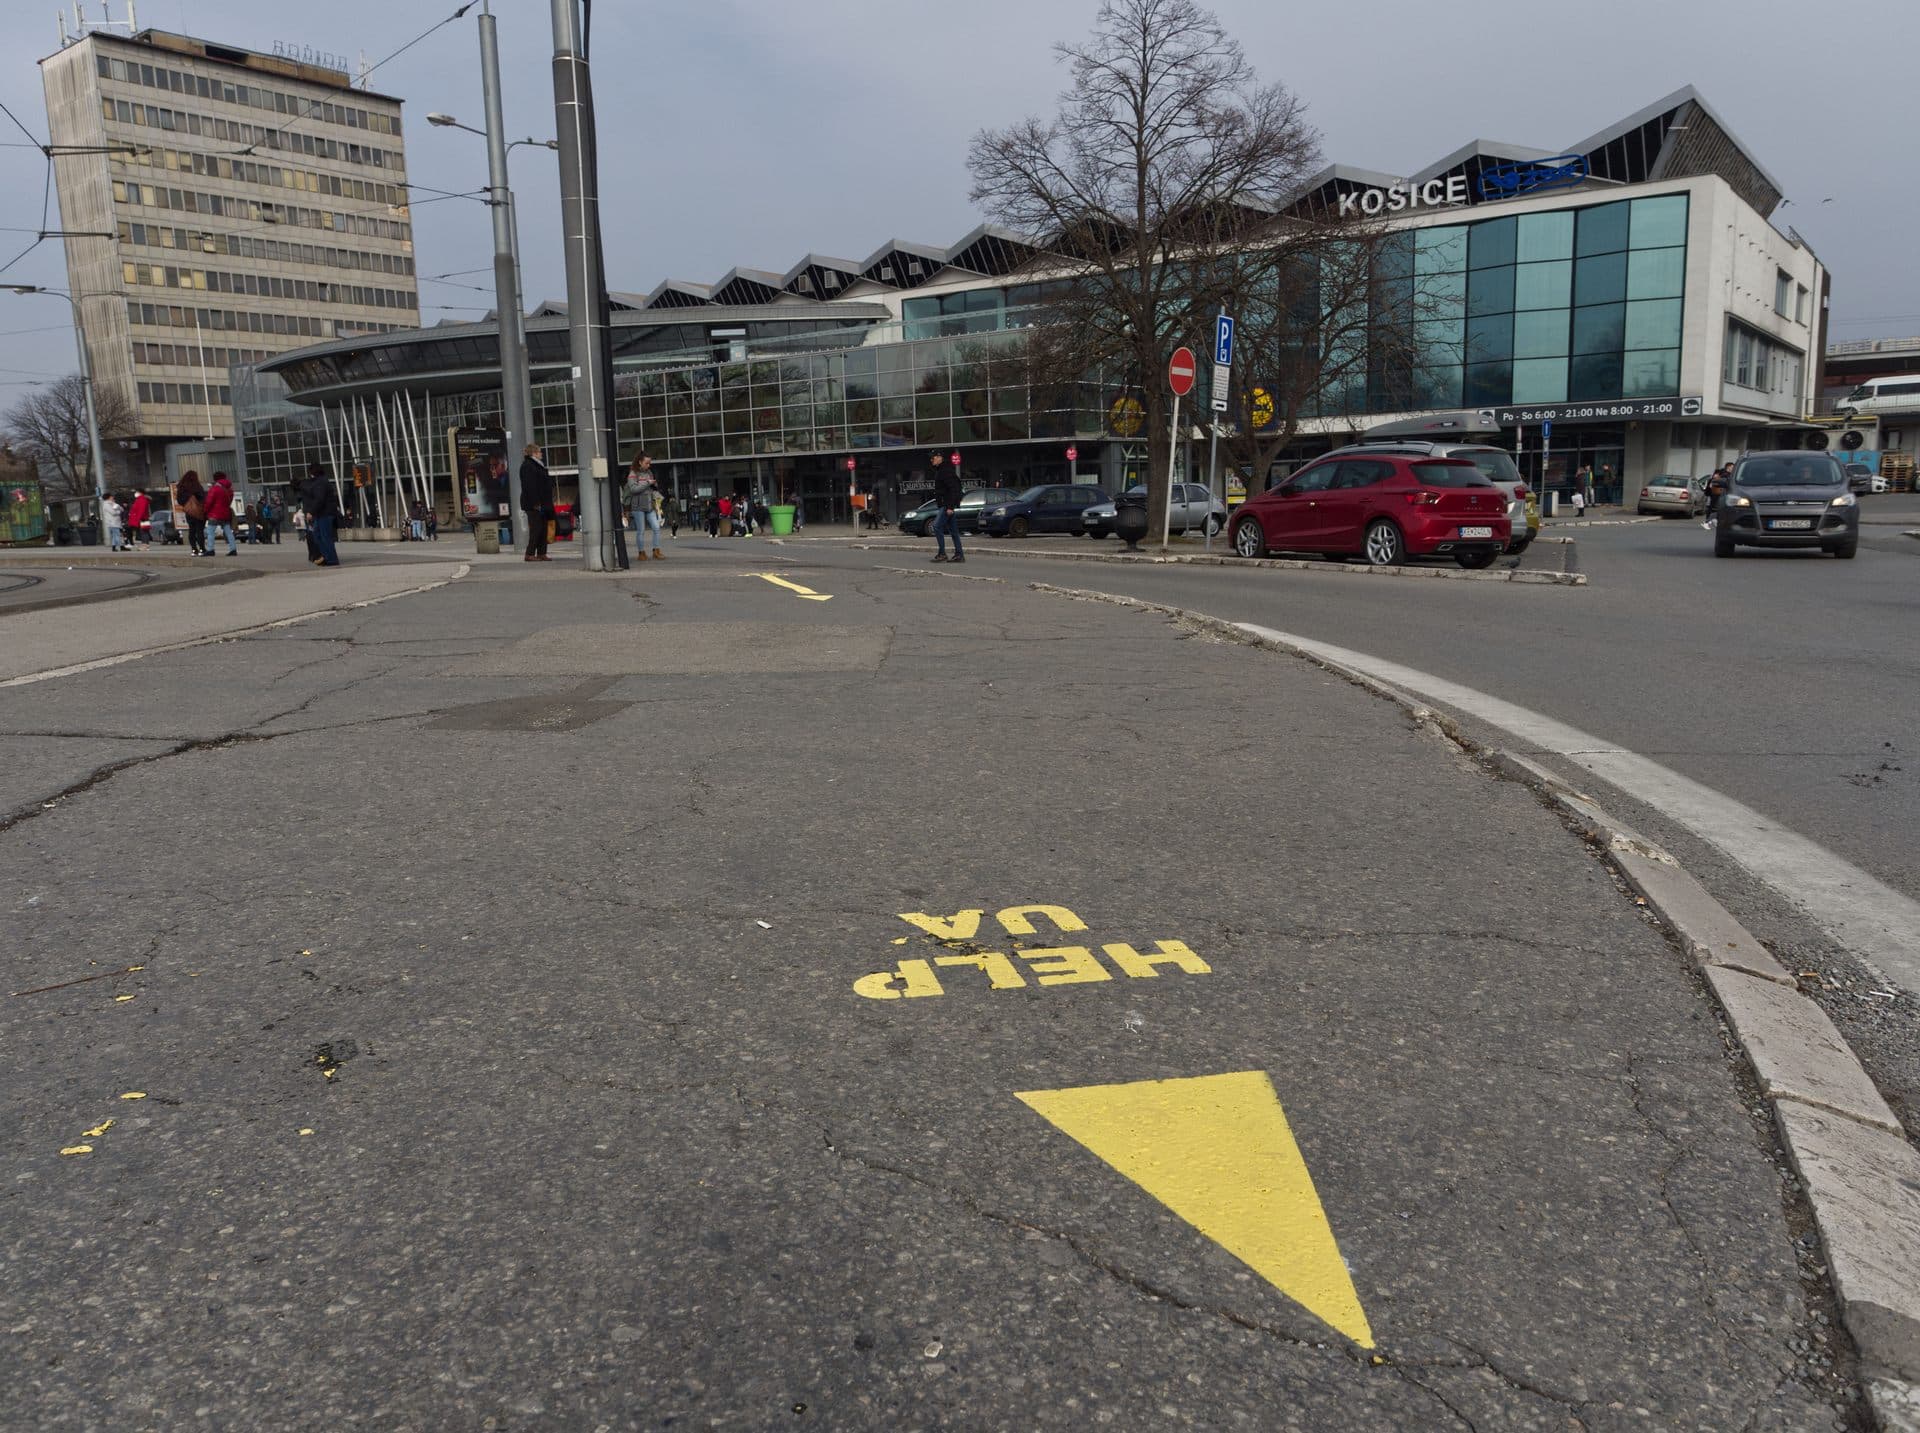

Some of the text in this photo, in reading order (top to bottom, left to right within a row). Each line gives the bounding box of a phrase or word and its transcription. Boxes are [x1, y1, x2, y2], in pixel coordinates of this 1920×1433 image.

[1339, 175, 1468, 217] KOŠICE
[1220, 322, 1229, 348] P
[1503, 412, 1514, 421] Po
[1521, 412, 1533, 421] So
[1535, 410, 1556, 420] 6:00
[1565, 408, 1593, 418] 21:00
[1595, 407, 1608, 416] Ne
[1610, 405, 1633, 415] 8:00
[1643, 403, 1673, 414] 21:00
[898, 904, 1089, 939] UA
[852, 939, 1212, 999] HELP
